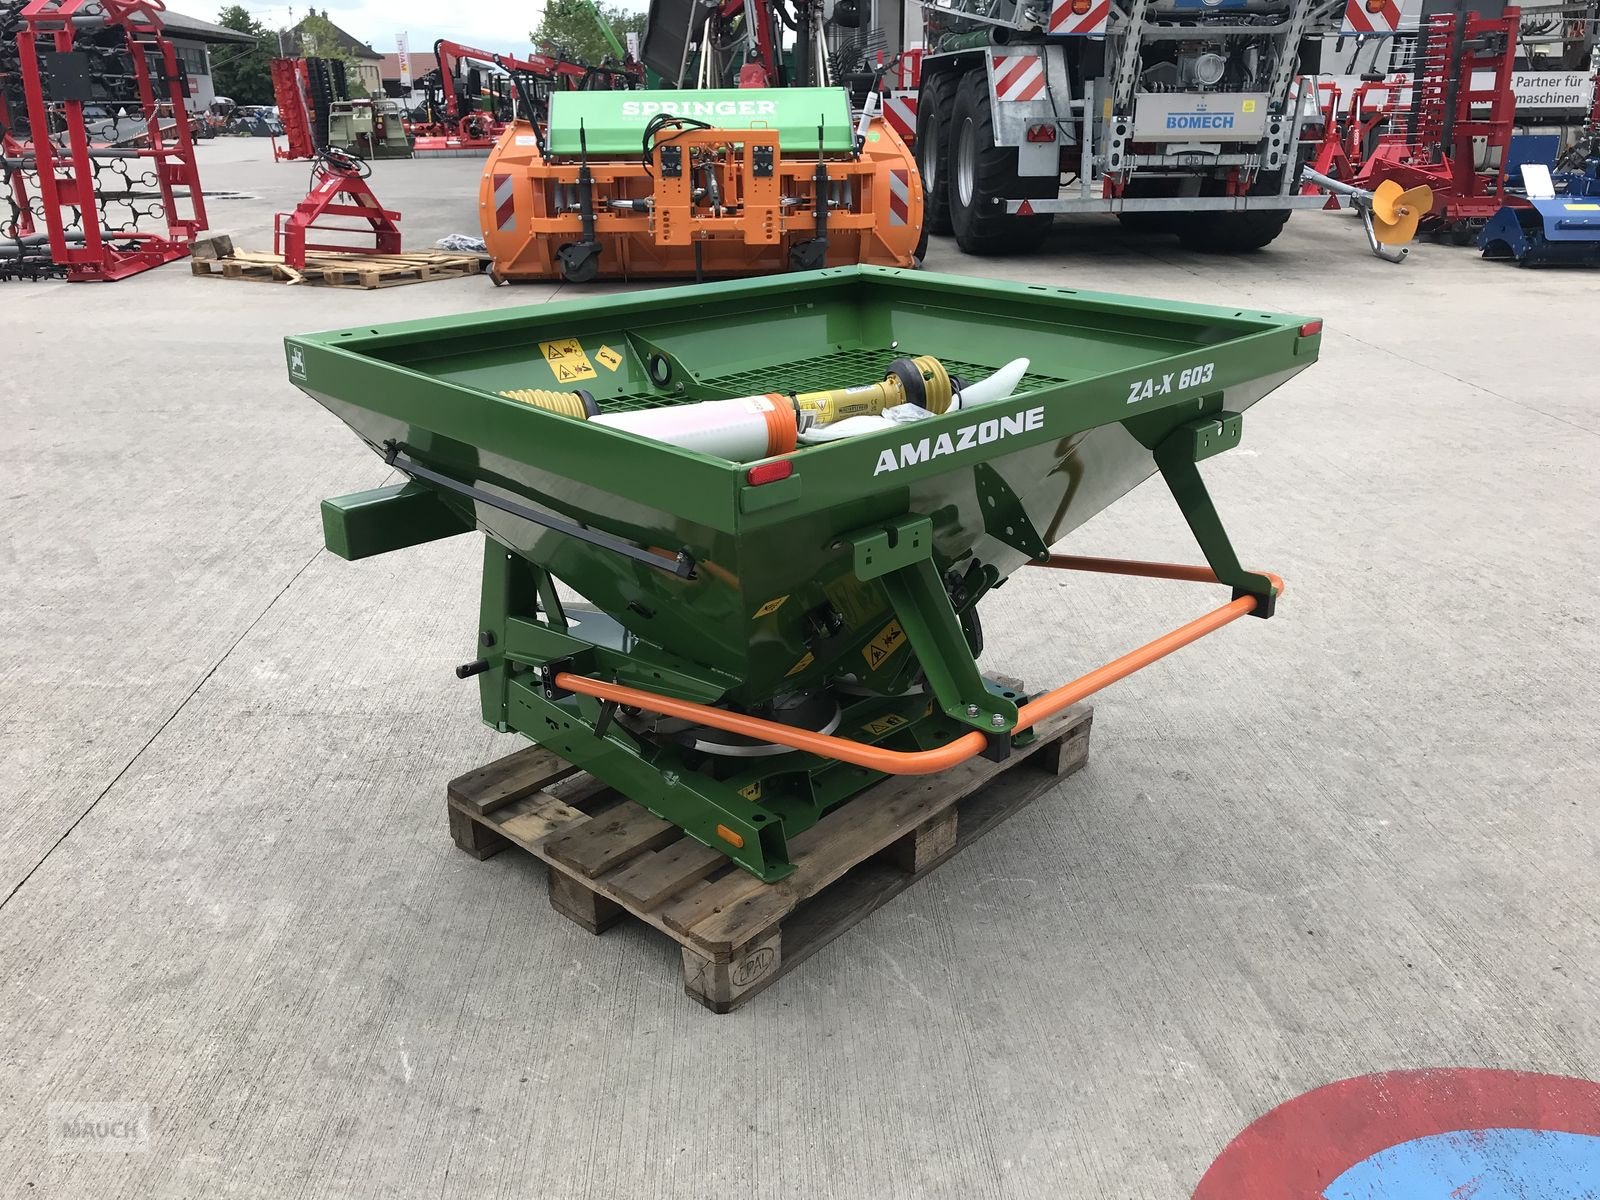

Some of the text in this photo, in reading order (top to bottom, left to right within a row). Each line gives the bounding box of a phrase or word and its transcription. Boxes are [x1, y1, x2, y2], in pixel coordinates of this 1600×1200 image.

[1515, 75, 1584, 89] Partner für
[1515, 91, 1580, 104] maschinen
[622, 100, 777, 116] SPRINGER
[1166, 116, 1235, 129] BOMECH
[1126, 362, 1215, 405] ZA-X 603
[873, 406, 1045, 476] AMAZONE
[740, 952, 770, 982] EPAL
